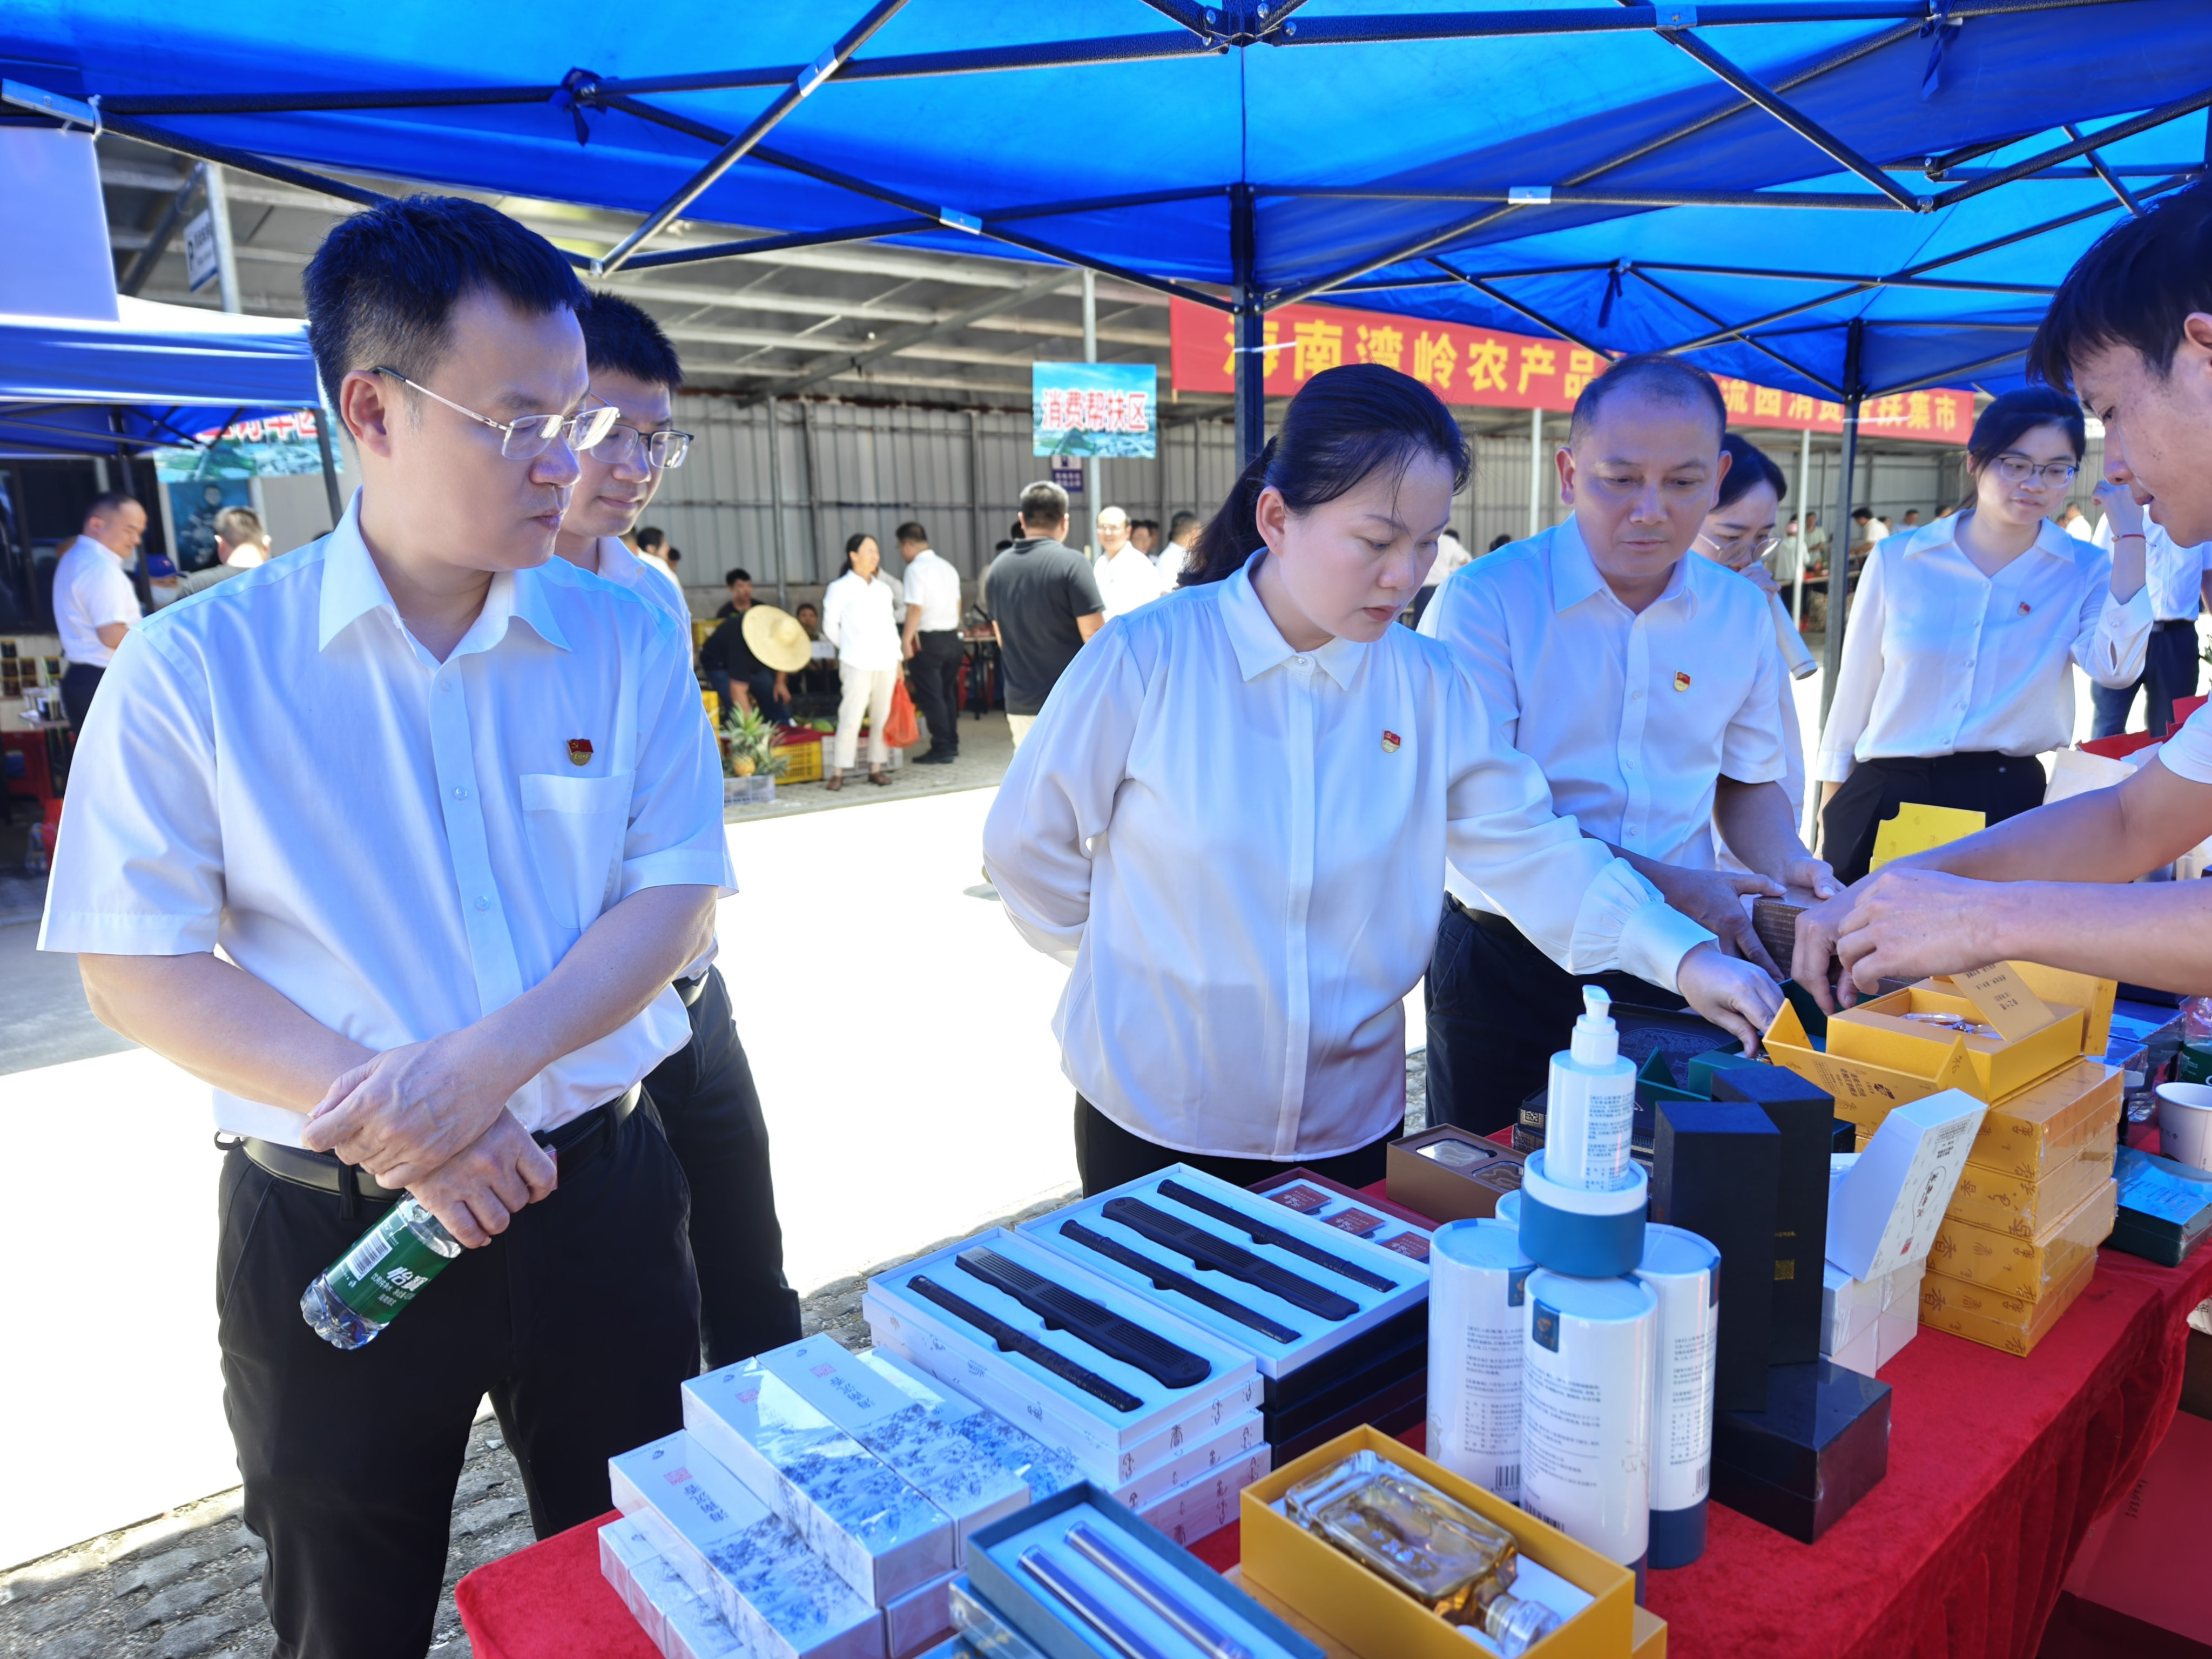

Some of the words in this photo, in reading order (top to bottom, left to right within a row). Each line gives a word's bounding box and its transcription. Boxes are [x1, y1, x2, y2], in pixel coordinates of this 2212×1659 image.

[1042, 389, 1147, 432] 消费帮扶区
[386, 1266, 429, 1292] 怡寶
[830, 1376, 875, 1410] 海南沉香
[684, 1483, 729, 1523] 海南沉香
